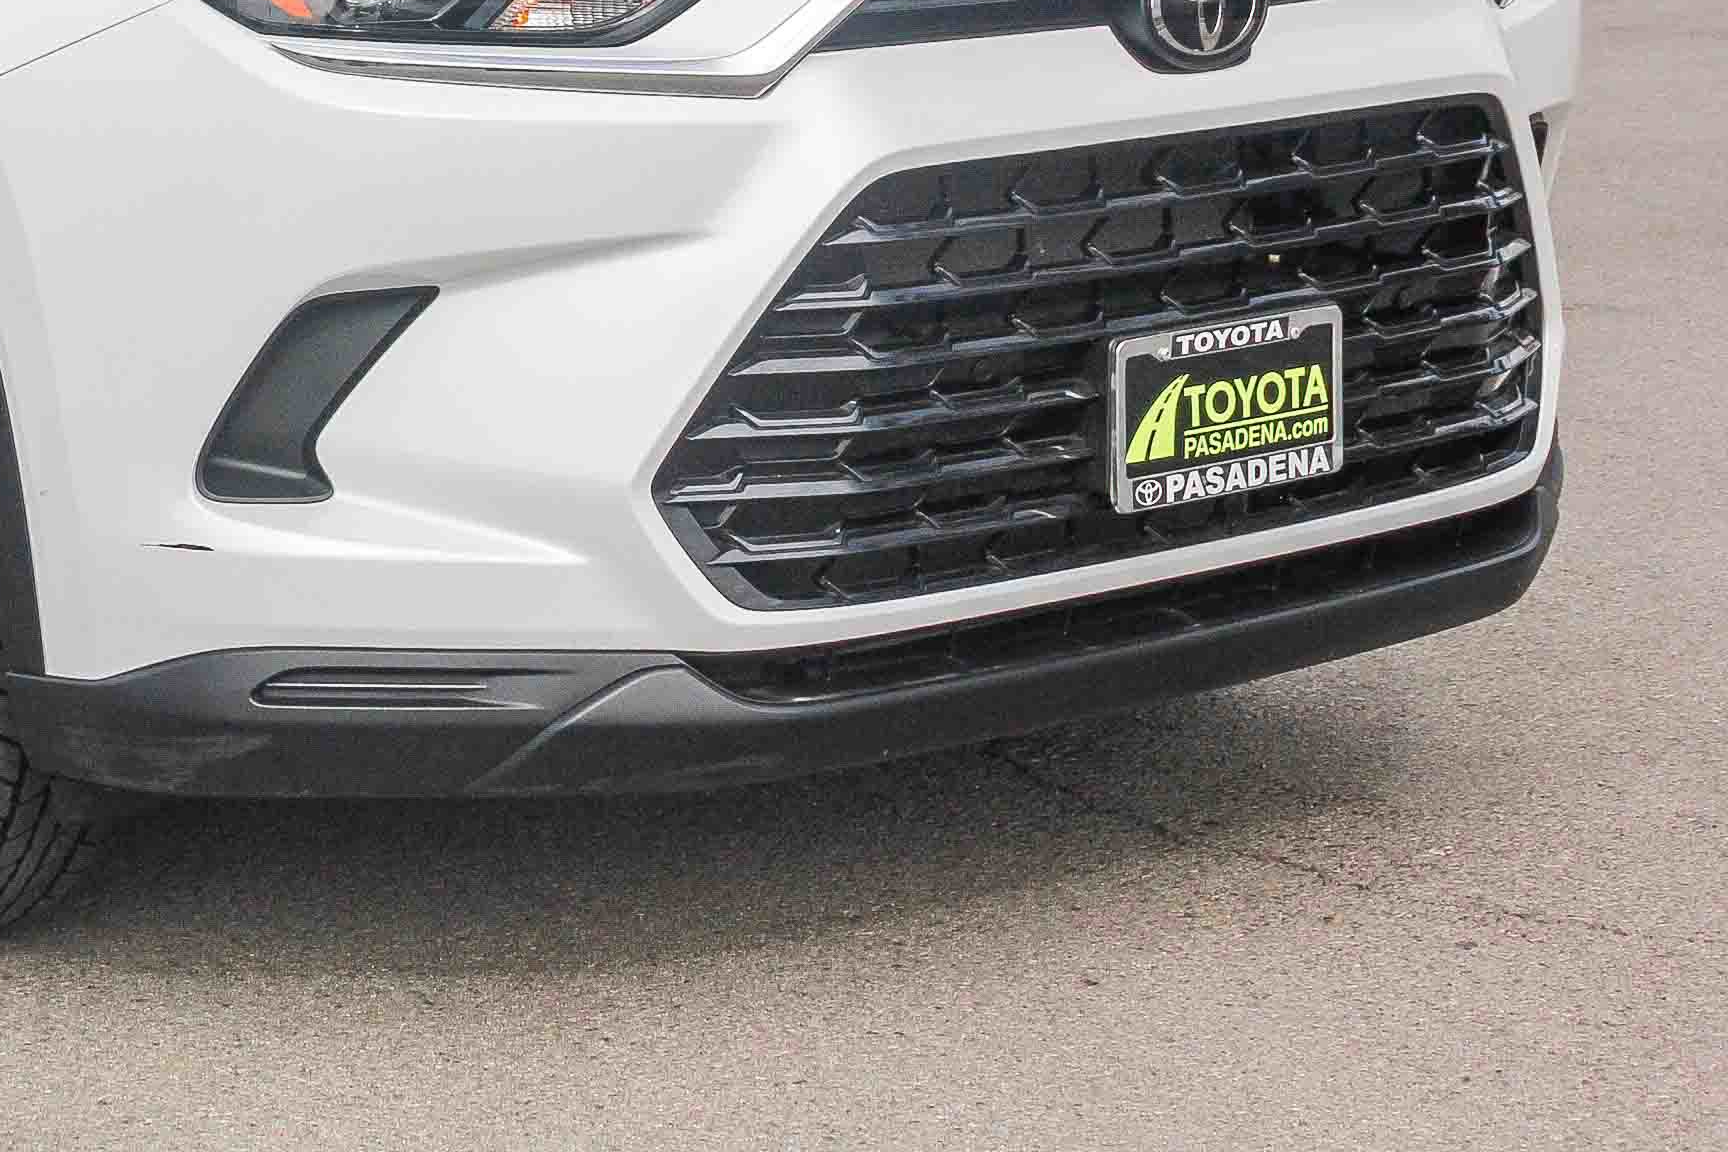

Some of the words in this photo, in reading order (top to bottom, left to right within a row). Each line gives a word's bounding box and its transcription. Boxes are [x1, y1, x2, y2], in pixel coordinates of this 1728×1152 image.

[1176, 319, 1284, 355] TOYOTA
[1183, 364, 1328, 428] TOYOTA
[1184, 416, 1328, 459] PASADENA.com
[1166, 446, 1331, 503] PASADENA
